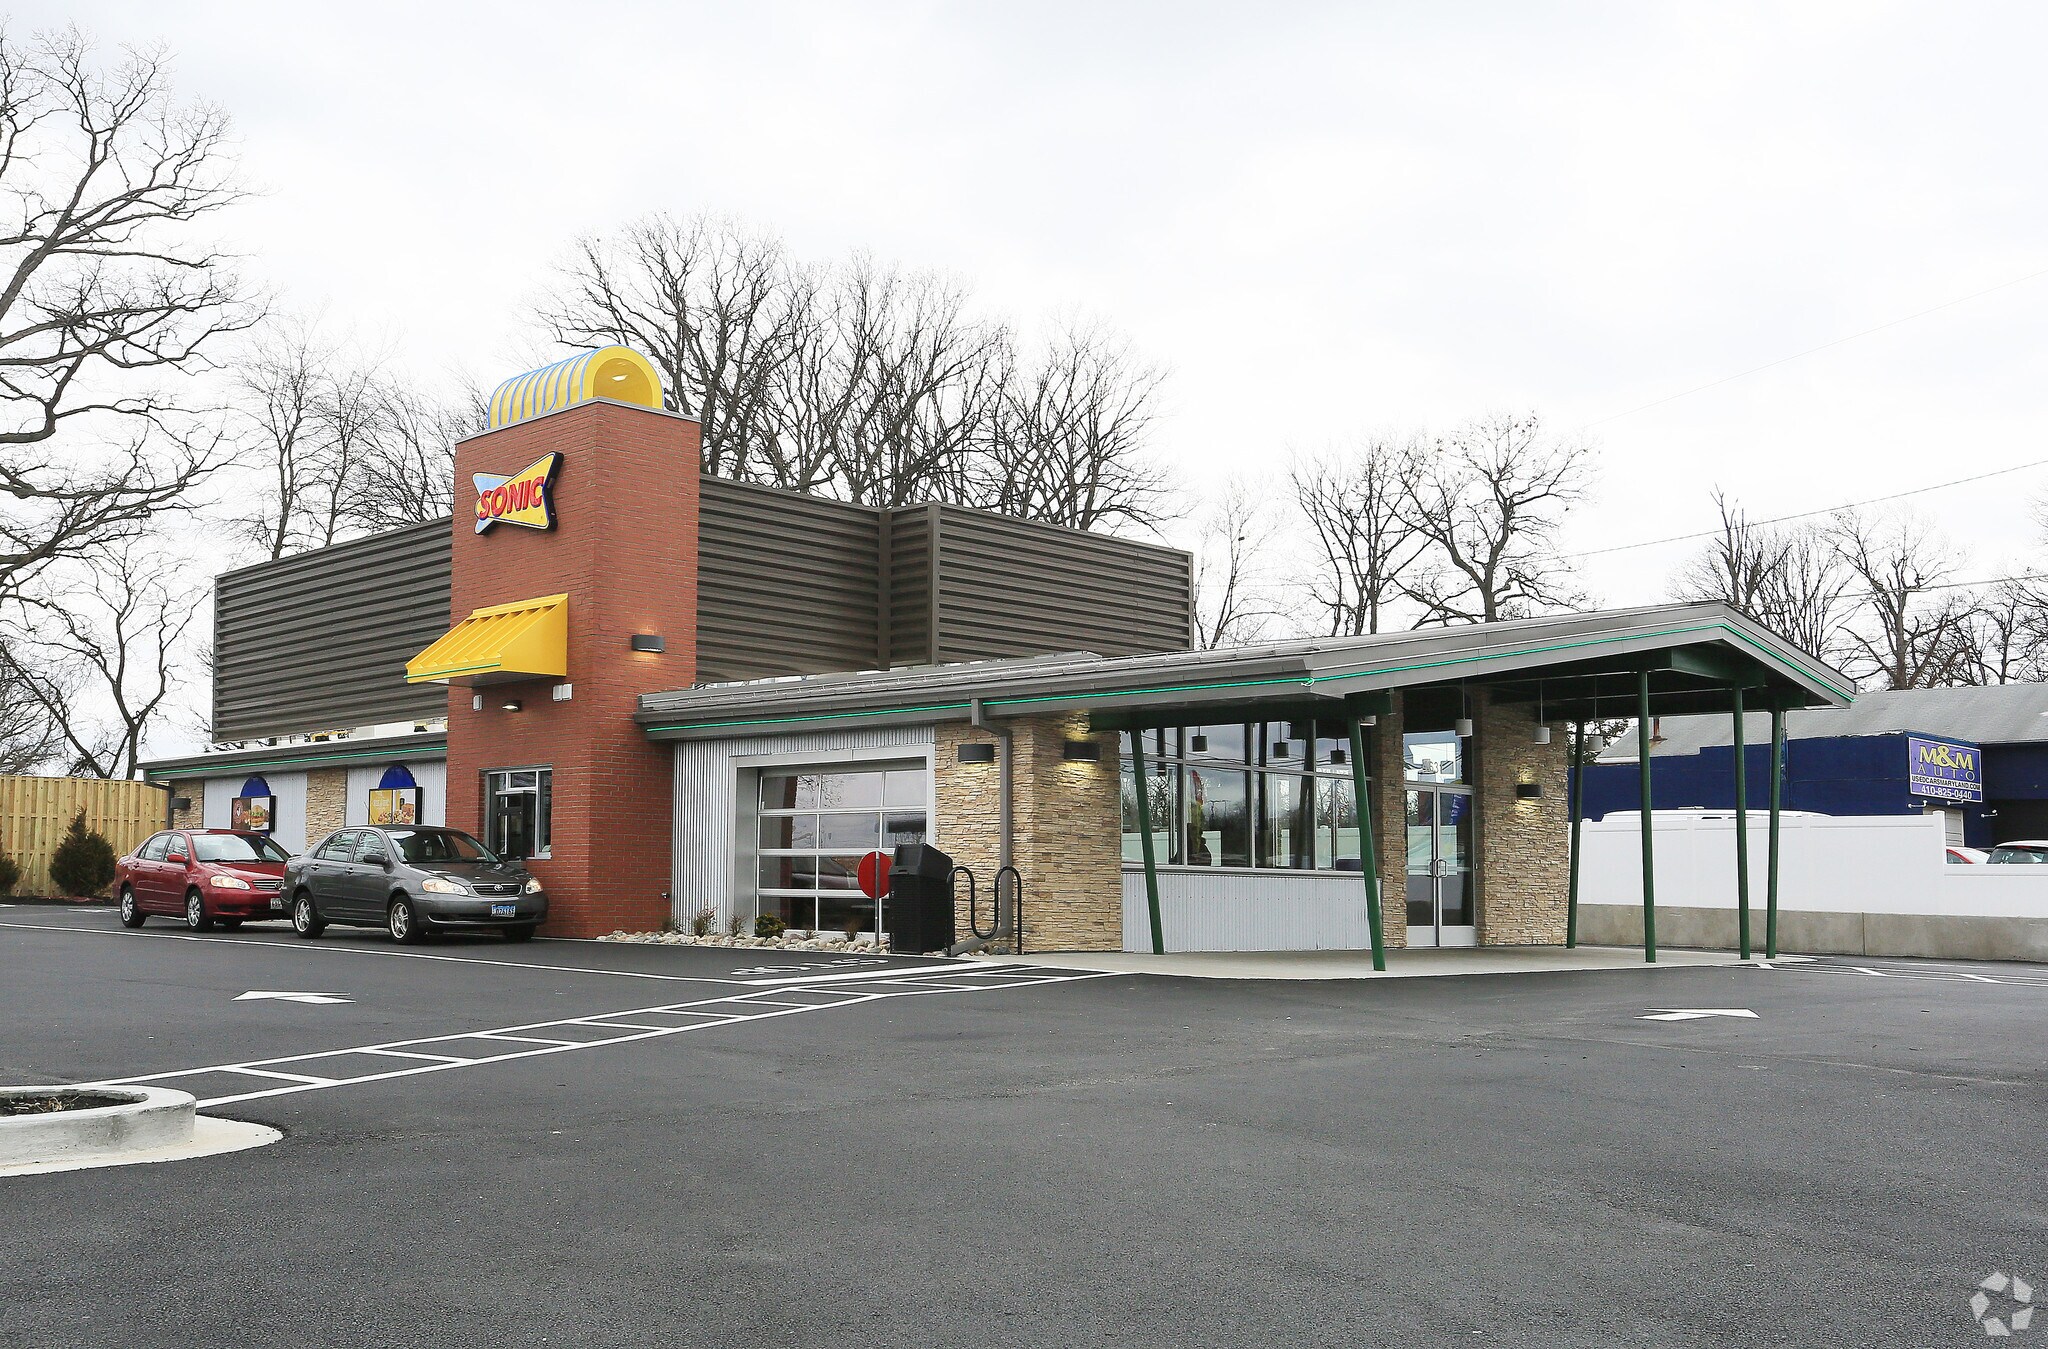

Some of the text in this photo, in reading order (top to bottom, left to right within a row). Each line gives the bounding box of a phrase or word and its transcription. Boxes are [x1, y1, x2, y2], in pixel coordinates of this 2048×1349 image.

[479, 476, 545, 520] SONIC
[1919, 745, 1974, 770] M&M
[1911, 775, 1981, 791] USEDCARSMARYLAND.COM
[1921, 785, 1973, 800] 410-825-0440
